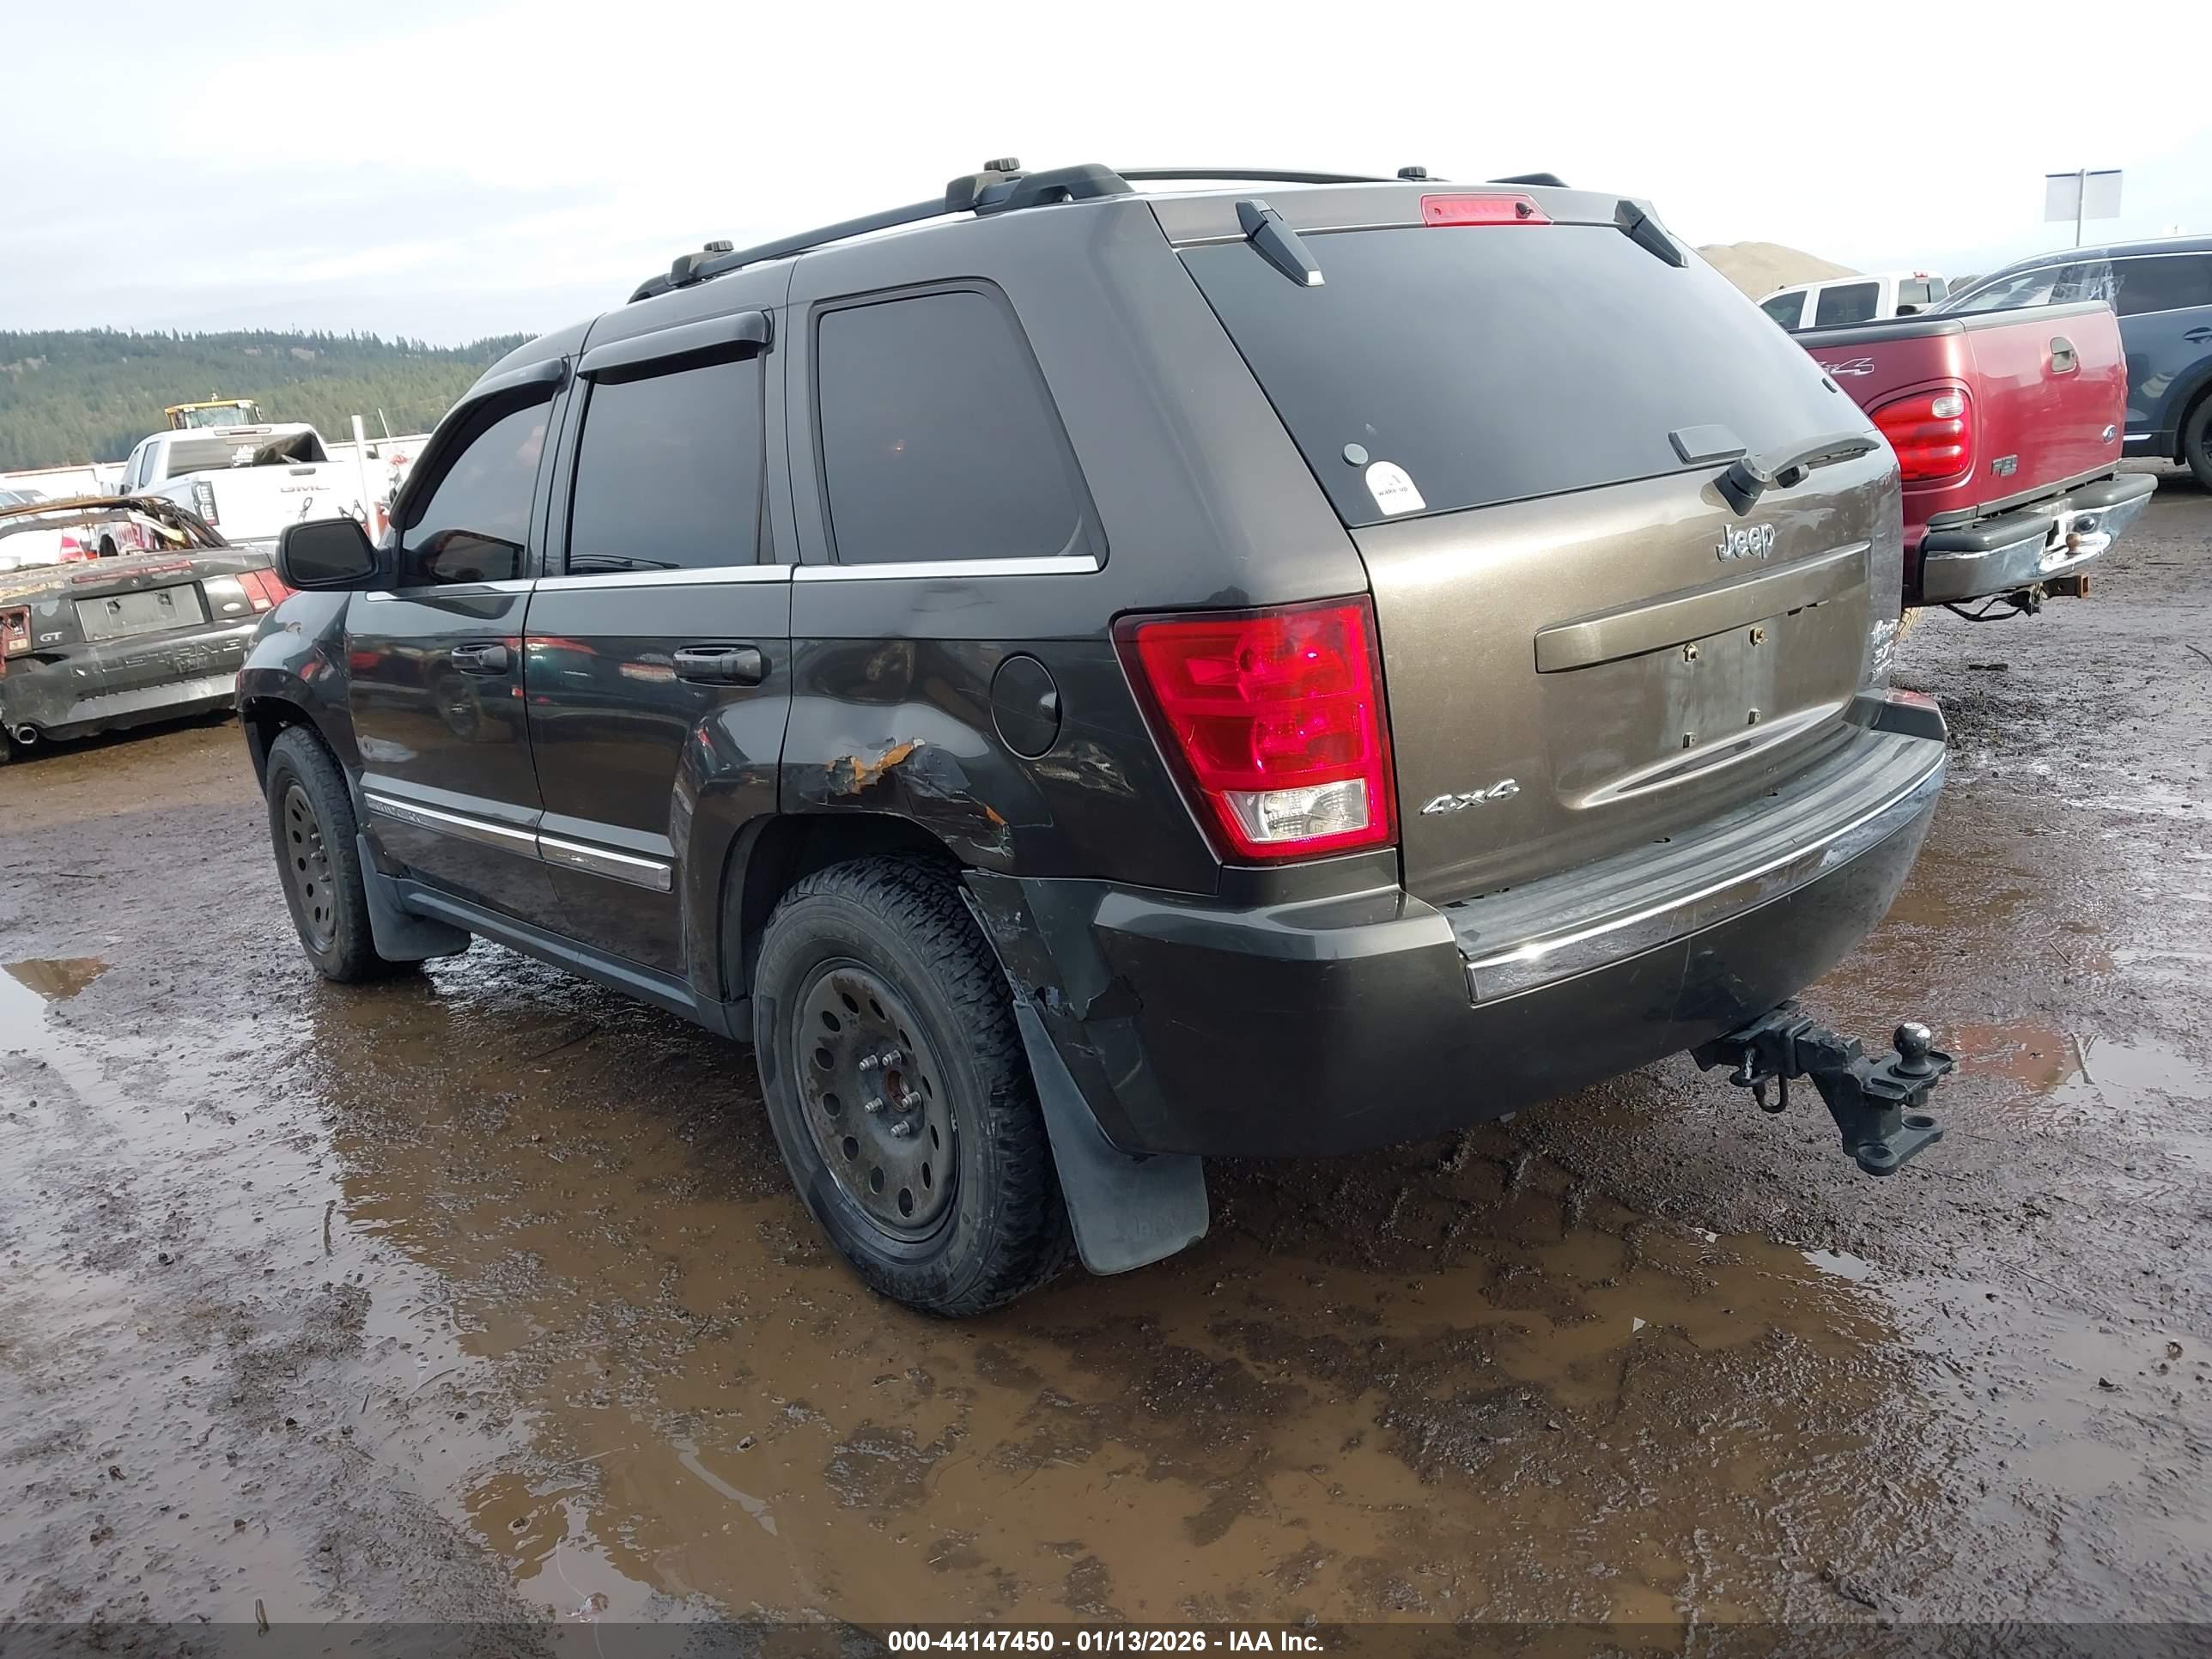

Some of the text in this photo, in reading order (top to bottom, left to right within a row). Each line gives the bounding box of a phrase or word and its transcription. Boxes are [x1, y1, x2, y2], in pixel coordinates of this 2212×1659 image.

[1716, 523, 1776, 563] Jeep
[40, 631, 64, 643] GT
[1419, 777, 1520, 817] 4x4
